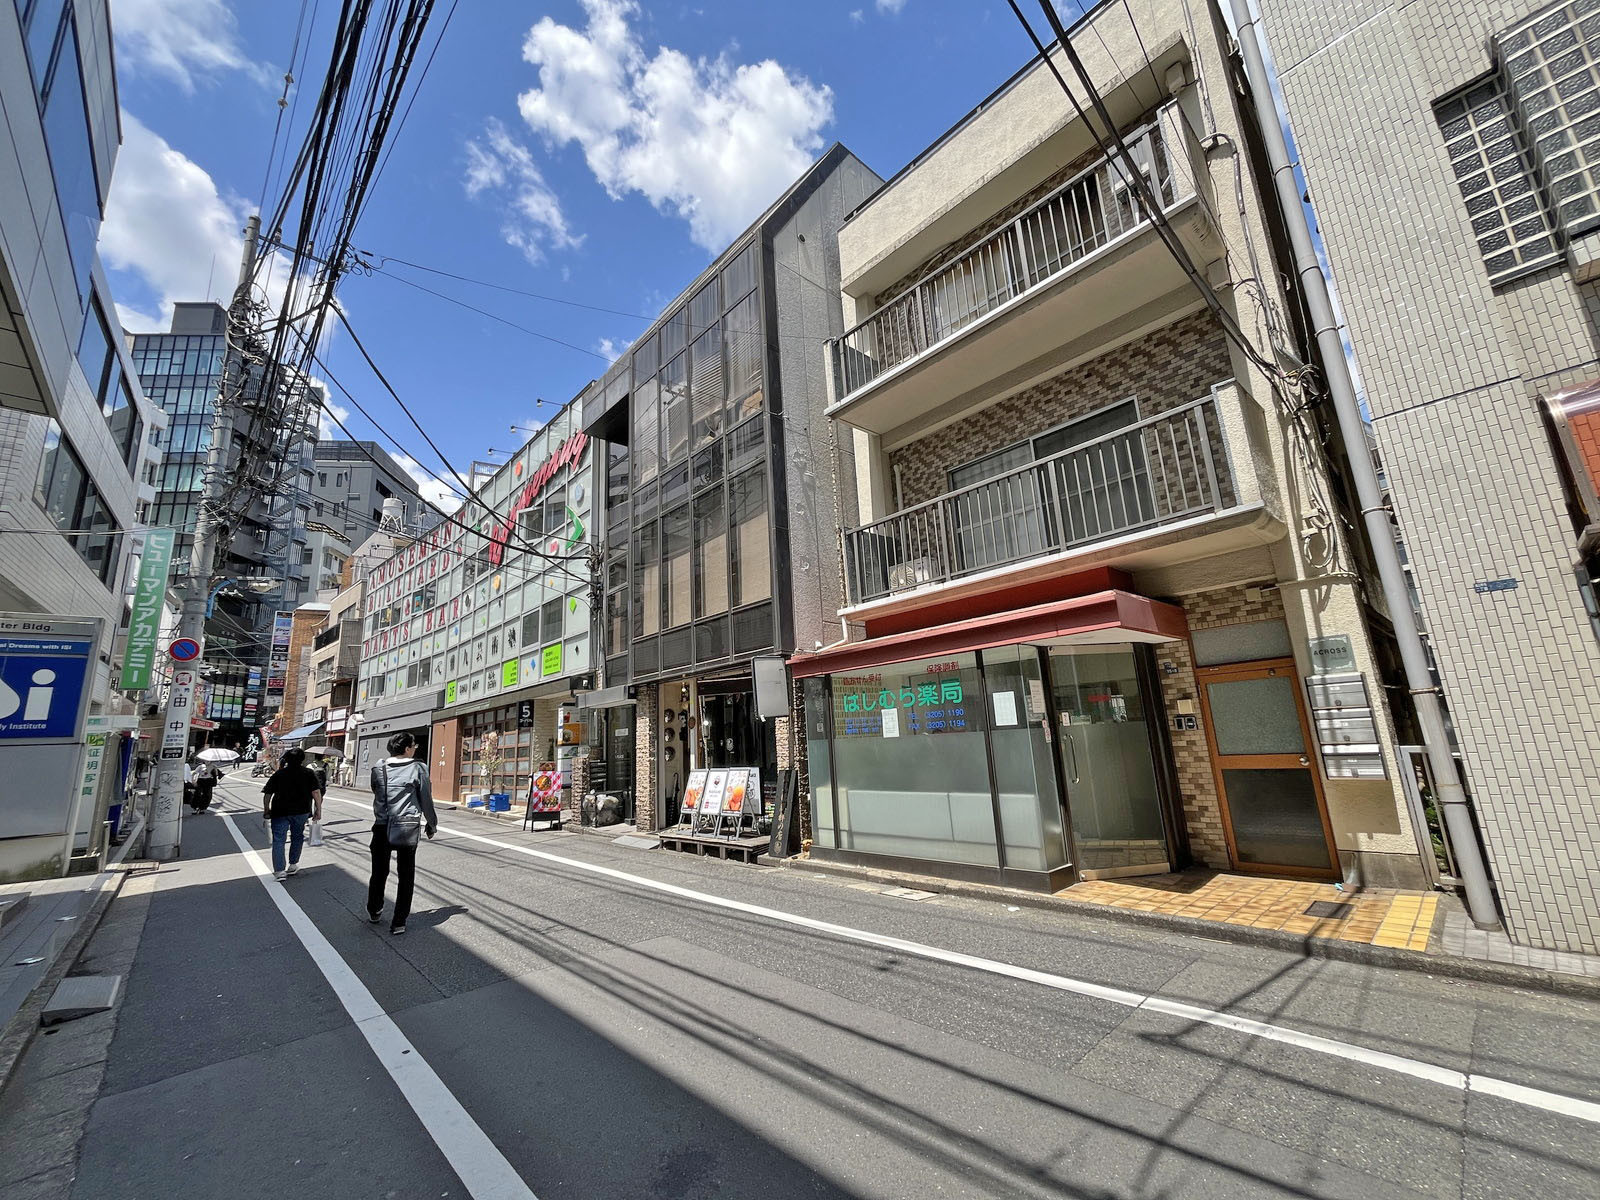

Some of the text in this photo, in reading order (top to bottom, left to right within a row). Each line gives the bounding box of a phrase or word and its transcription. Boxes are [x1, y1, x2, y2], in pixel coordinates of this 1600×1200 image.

[369, 510, 466, 591] AMUSEMENT
[367, 543, 463, 614] BILLIARDS
[129, 534, 167, 683] ヒューマンアカデミー
[22, 622, 54, 632] Bldg.
[364, 622, 409, 659] DARTS
[425, 597, 459, 633] BAR
[1313, 646, 1348, 656] ACROSS
[843, 681, 963, 713] はしむら薬局
[522, 705, 530, 718] 5
[947, 708, 965, 717] 1190
[948, 718, 967, 728] 1194
